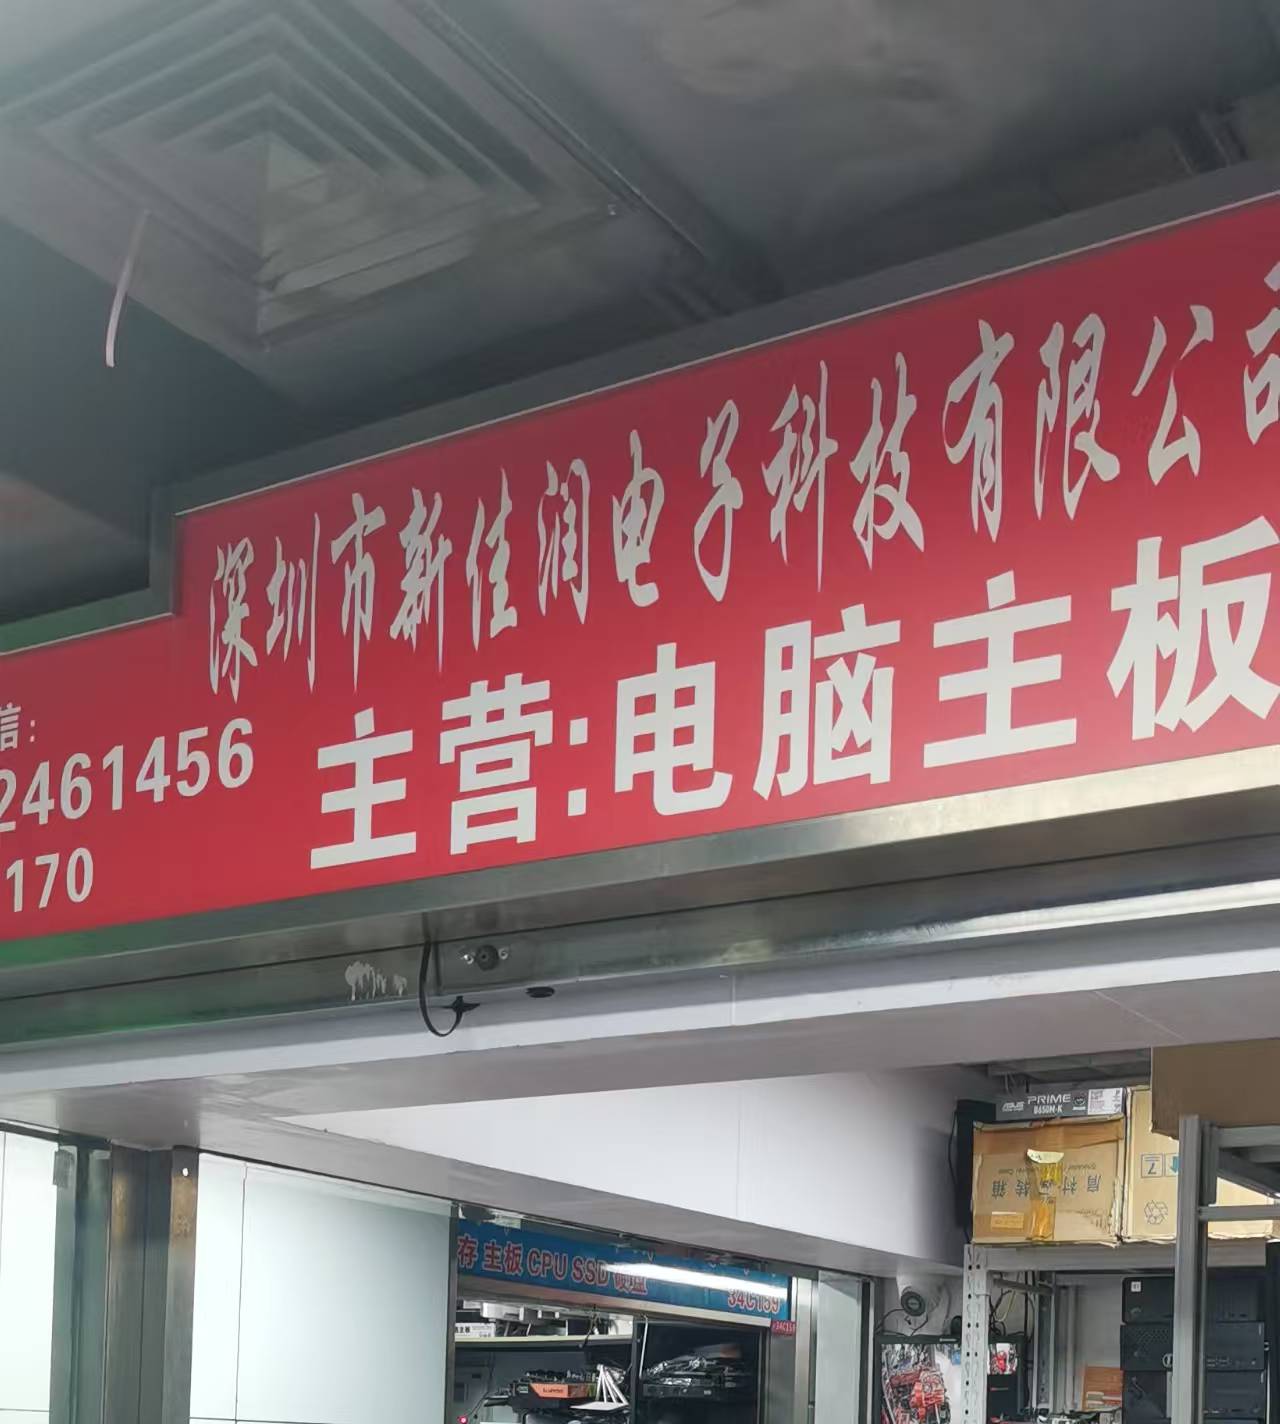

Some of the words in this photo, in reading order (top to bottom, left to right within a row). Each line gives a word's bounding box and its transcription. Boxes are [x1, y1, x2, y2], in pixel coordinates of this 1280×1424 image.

[310, 514, 1280, 870] 主营:电脑主板
[0, 717, 254, 833] 2461456
[6, 847, 94, 913] 170
[1027, 1093, 1072, 1104] PRIME
[457, 1232, 479, 1268] 存
[484, 1240, 524, 1277] 主板
[526, 1246, 569, 1280] CPU
[571, 1256, 610, 1288] SSD
